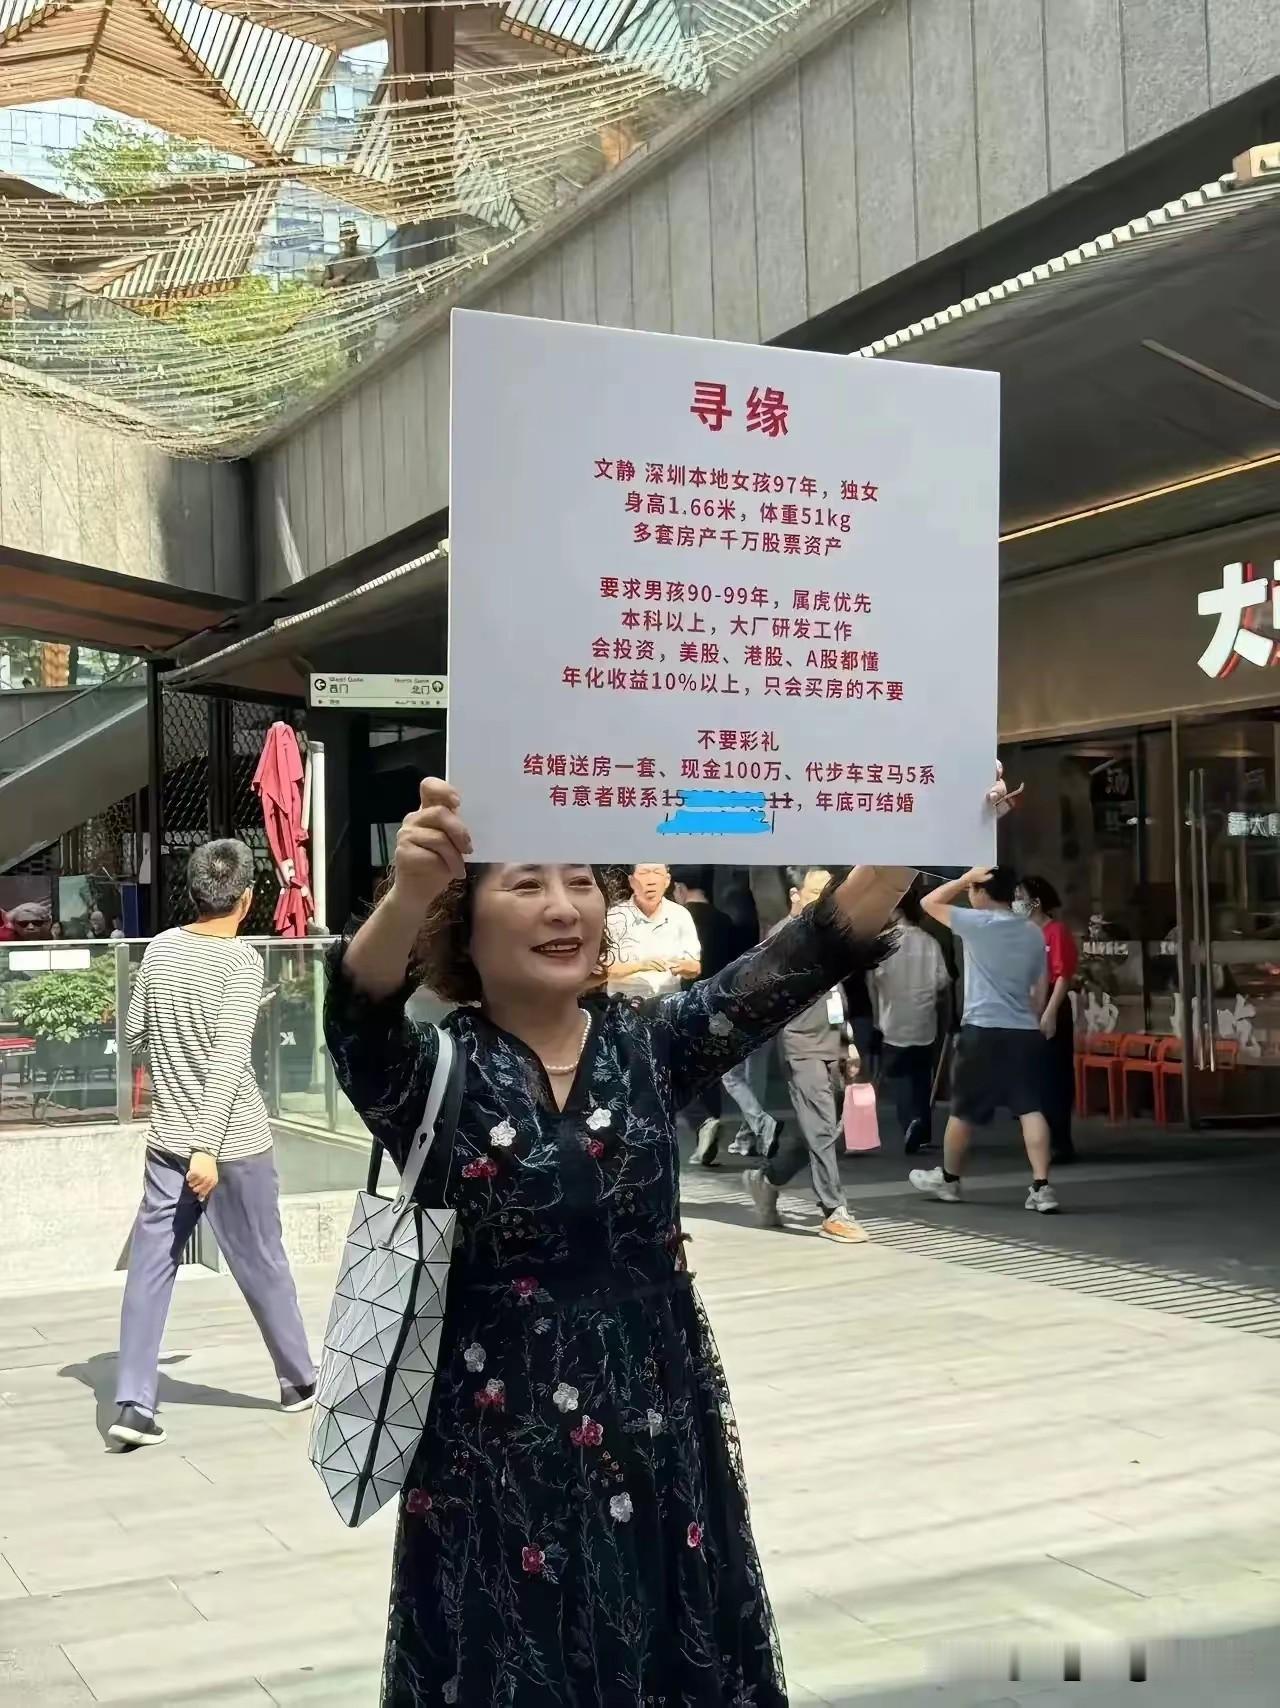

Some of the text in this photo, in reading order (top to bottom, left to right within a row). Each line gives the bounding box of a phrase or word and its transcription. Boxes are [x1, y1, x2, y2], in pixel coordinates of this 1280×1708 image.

[594, 457, 879, 502] 文静 深圳本地女孩97年，独女
[633, 521, 843, 556] 多套房产千万股票资产
[599, 576, 872, 613] 要求男孩90-99年，属虎优先
[621, 608, 852, 642] 本科以上，大厂研发工作
[1197, 560, 1280, 679] 大
[591, 637, 880, 673] 会投资，美股、港股、A股都懂
[561, 666, 904, 702] 年化收益10%以上，只会买房的不要
[697, 729, 780, 752] 不要彩礼
[523, 753, 935, 785] 结婚送房一套、现金100万、代步车宝马5系
